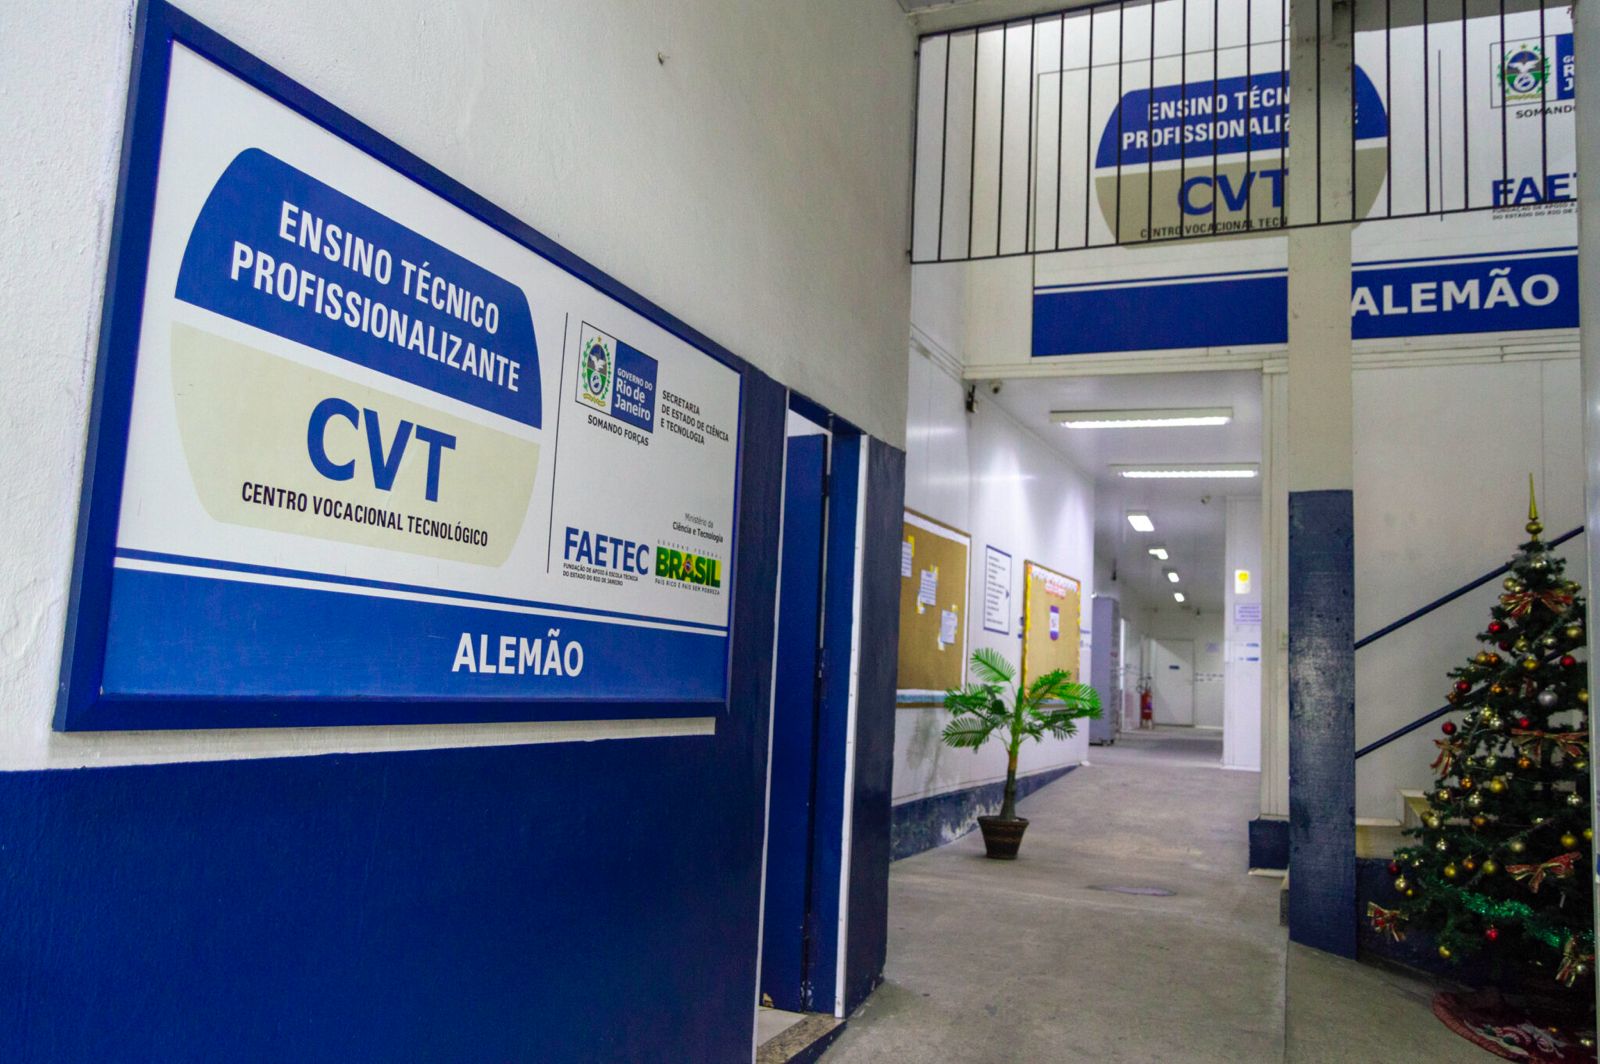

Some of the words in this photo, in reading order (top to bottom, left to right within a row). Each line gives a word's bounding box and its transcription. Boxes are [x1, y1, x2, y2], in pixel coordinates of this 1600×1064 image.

[1148, 94, 1228, 122] ENSINO
[1516, 105, 1575, 119] SOMAND
[1178, 168, 1289, 216] CVT
[1492, 172, 1577, 208] FAE
[1140, 225, 1182, 239] CNTRO
[278, 200, 393, 285] ENSINO
[401, 260, 500, 335] TÉCNICO
[1351, 267, 1560, 317] ALEMÃO
[230, 240, 521, 393] PROFISSIONALIZANTE
[616, 378, 631, 397] Rio
[633, 388, 645, 404] de
[617, 367, 644, 387] GOVERNO
[644, 380, 653, 391] DO
[615, 395, 651, 421] Janeiro
[661, 404, 673, 417] DE
[673, 408, 696, 427] ESTADO
[697, 418, 705, 431] DE
[662, 390, 700, 415] SECRETARIA
[587, 414, 623, 436] SOMANDO
[624, 427, 649, 446] FORÇAS
[660, 417, 665, 428] E
[666, 419, 705, 445] TECNOLOGIA
[306, 397, 457, 503] CVT
[241, 481, 308, 512] CENTRO
[312, 496, 403, 531] VOCACIONAL
[407, 515, 488, 547] TECNOLÓGICO
[672, 521, 691, 535] Ciência
[697, 528, 724, 543] Tecnologia
[564, 526, 650, 575] FAETEC
[656, 546, 721, 588] BRASIL
[451, 628, 584, 677] ALEMÃO
